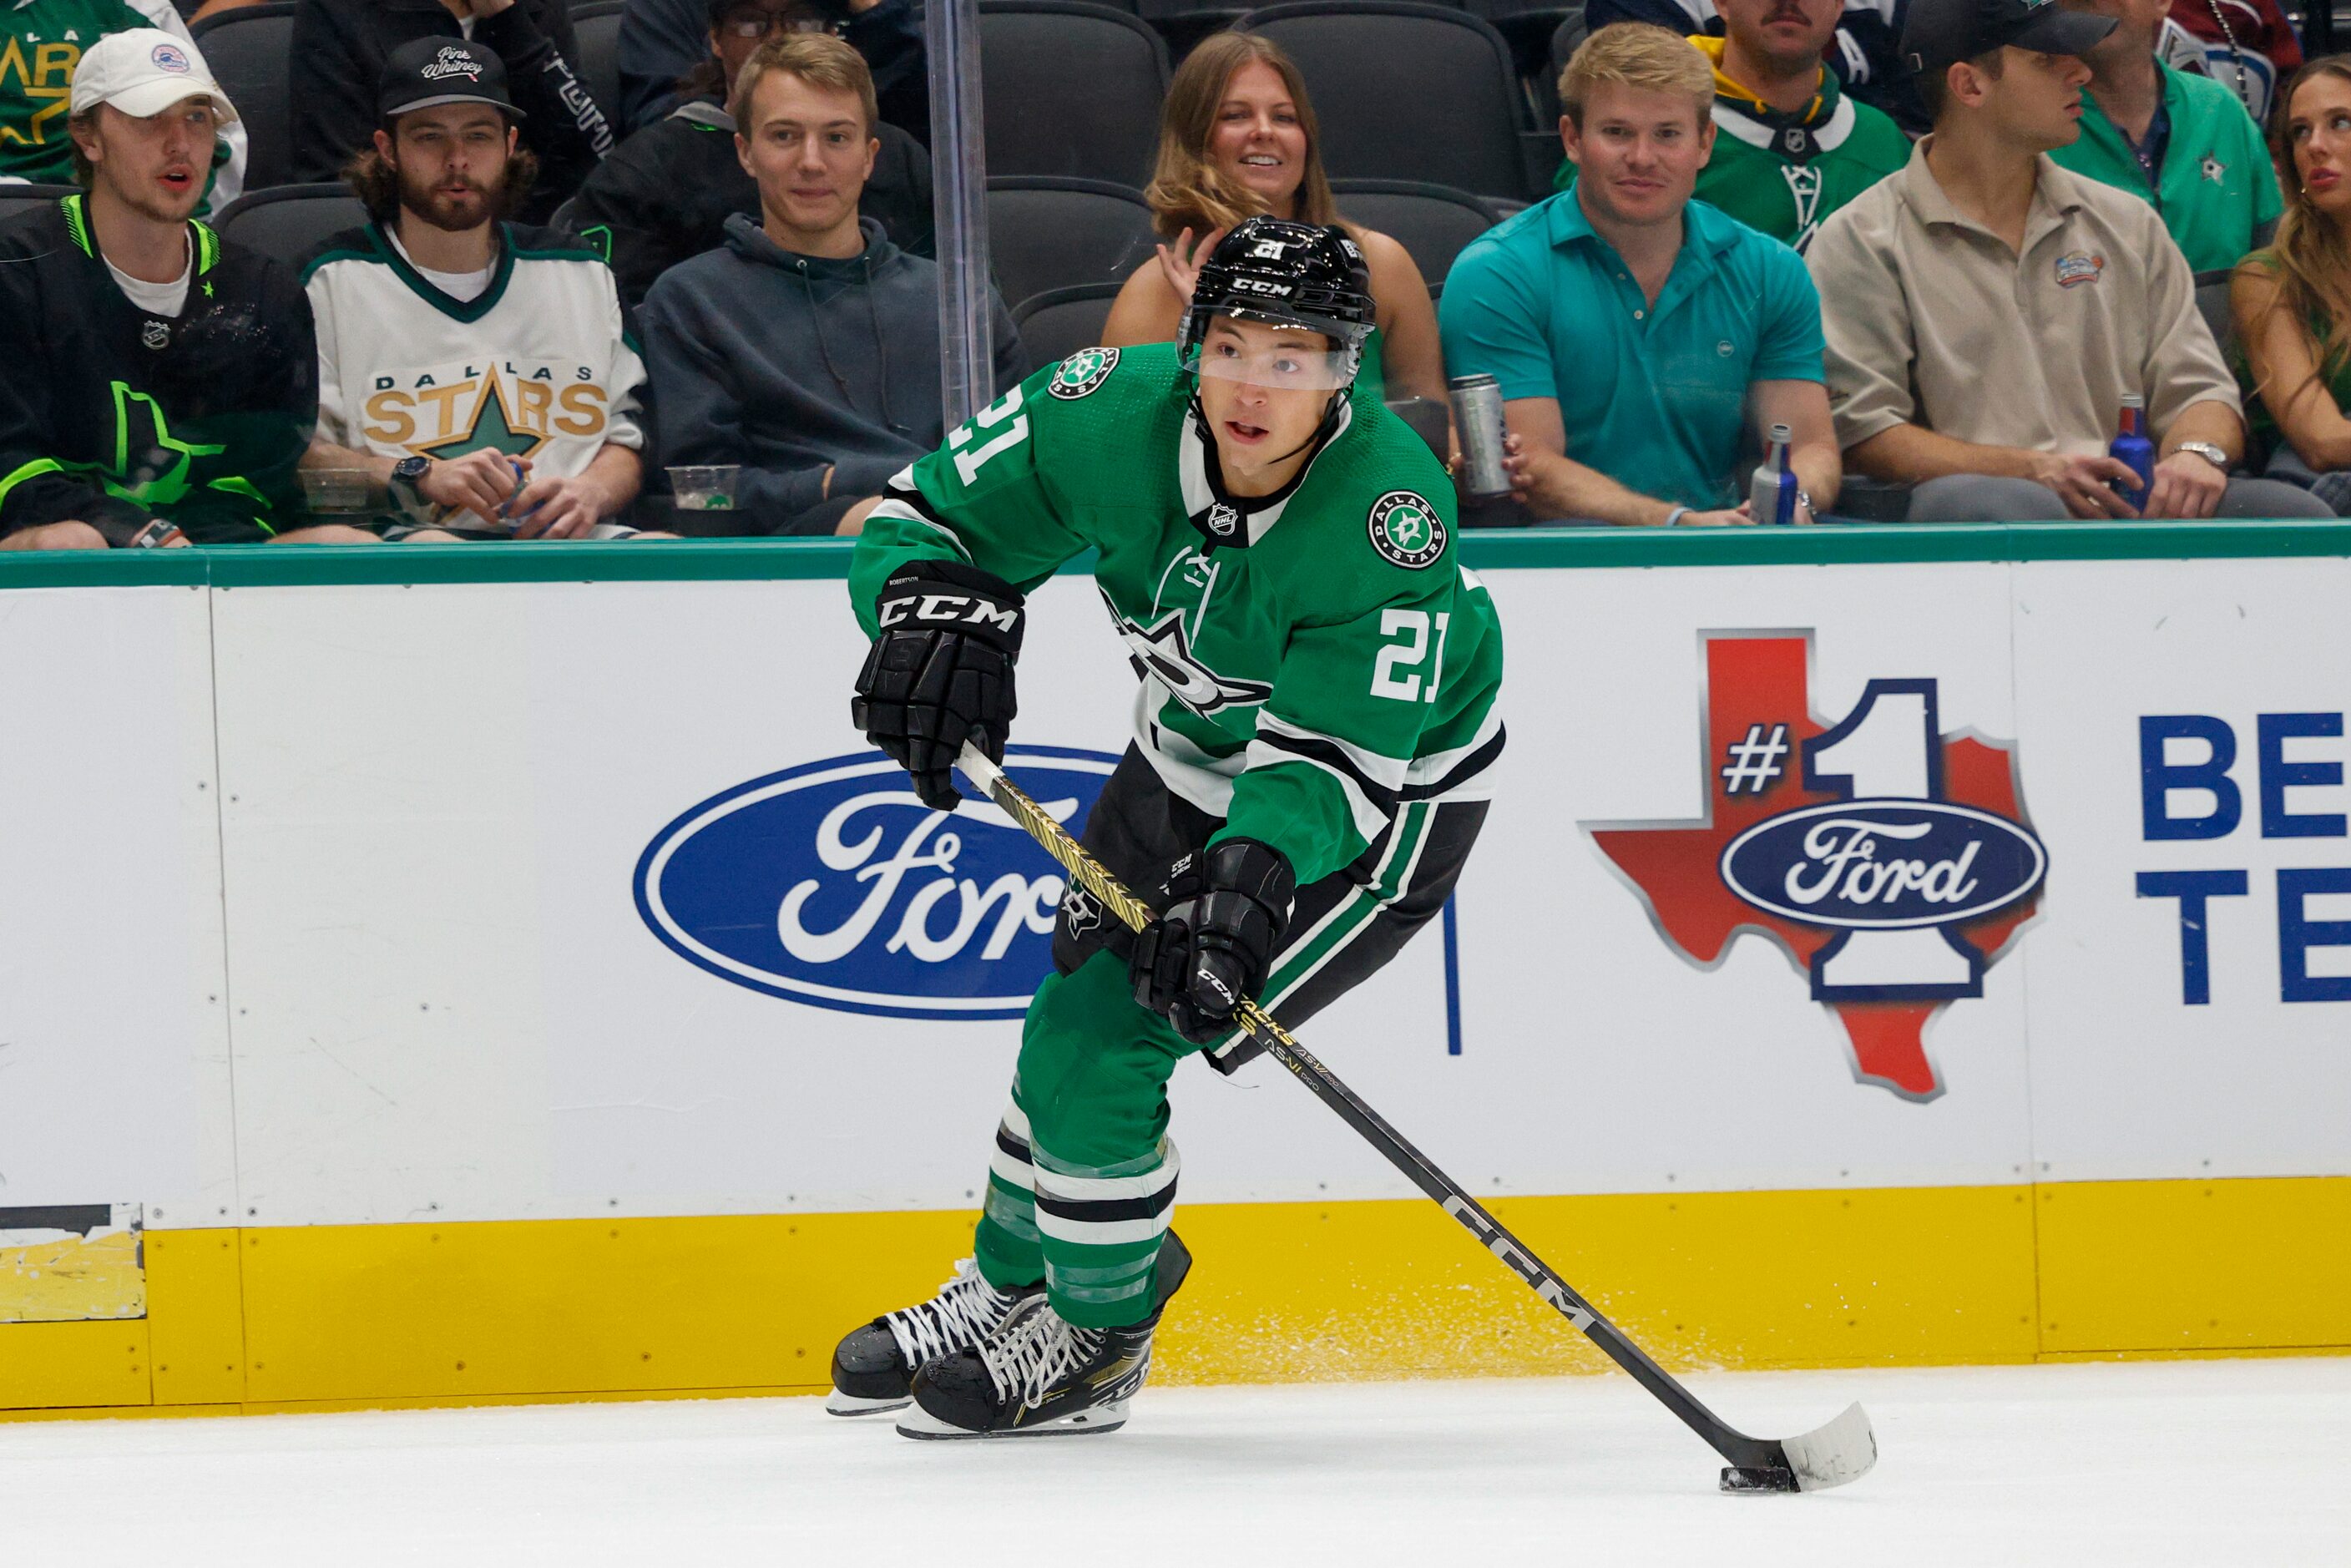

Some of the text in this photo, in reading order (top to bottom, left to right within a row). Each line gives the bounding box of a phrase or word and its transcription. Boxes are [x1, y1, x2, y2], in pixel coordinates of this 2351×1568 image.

[421, 59, 483, 78] Whitney
[437, 46, 472, 63] Pink
[1253, 239, 1287, 260] 21
[1232, 278, 1293, 296] CCM
[376, 362, 592, 391] DALLAS
[363, 362, 609, 444] STARS
[948, 383, 1029, 488] 21
[1214, 516, 1231, 526] NHL
[1374, 496, 1430, 538] DALLAS
[1392, 530, 1443, 563] STARS
[889, 575, 919, 586] ROBERTSON
[879, 594, 1018, 633] CCM
[1370, 608, 1450, 703] 21
[2139, 712, 2348, 841] BE
[777, 790, 1079, 964] For
[1171, 852, 1192, 873] CCM
[1785, 818, 1983, 904] Ford
[2135, 867, 2351, 1004] TE
[1197, 968, 1235, 1005] CCM
[1301, 1071, 1320, 1091] PRO
[1442, 1195, 1596, 1333] CCM
